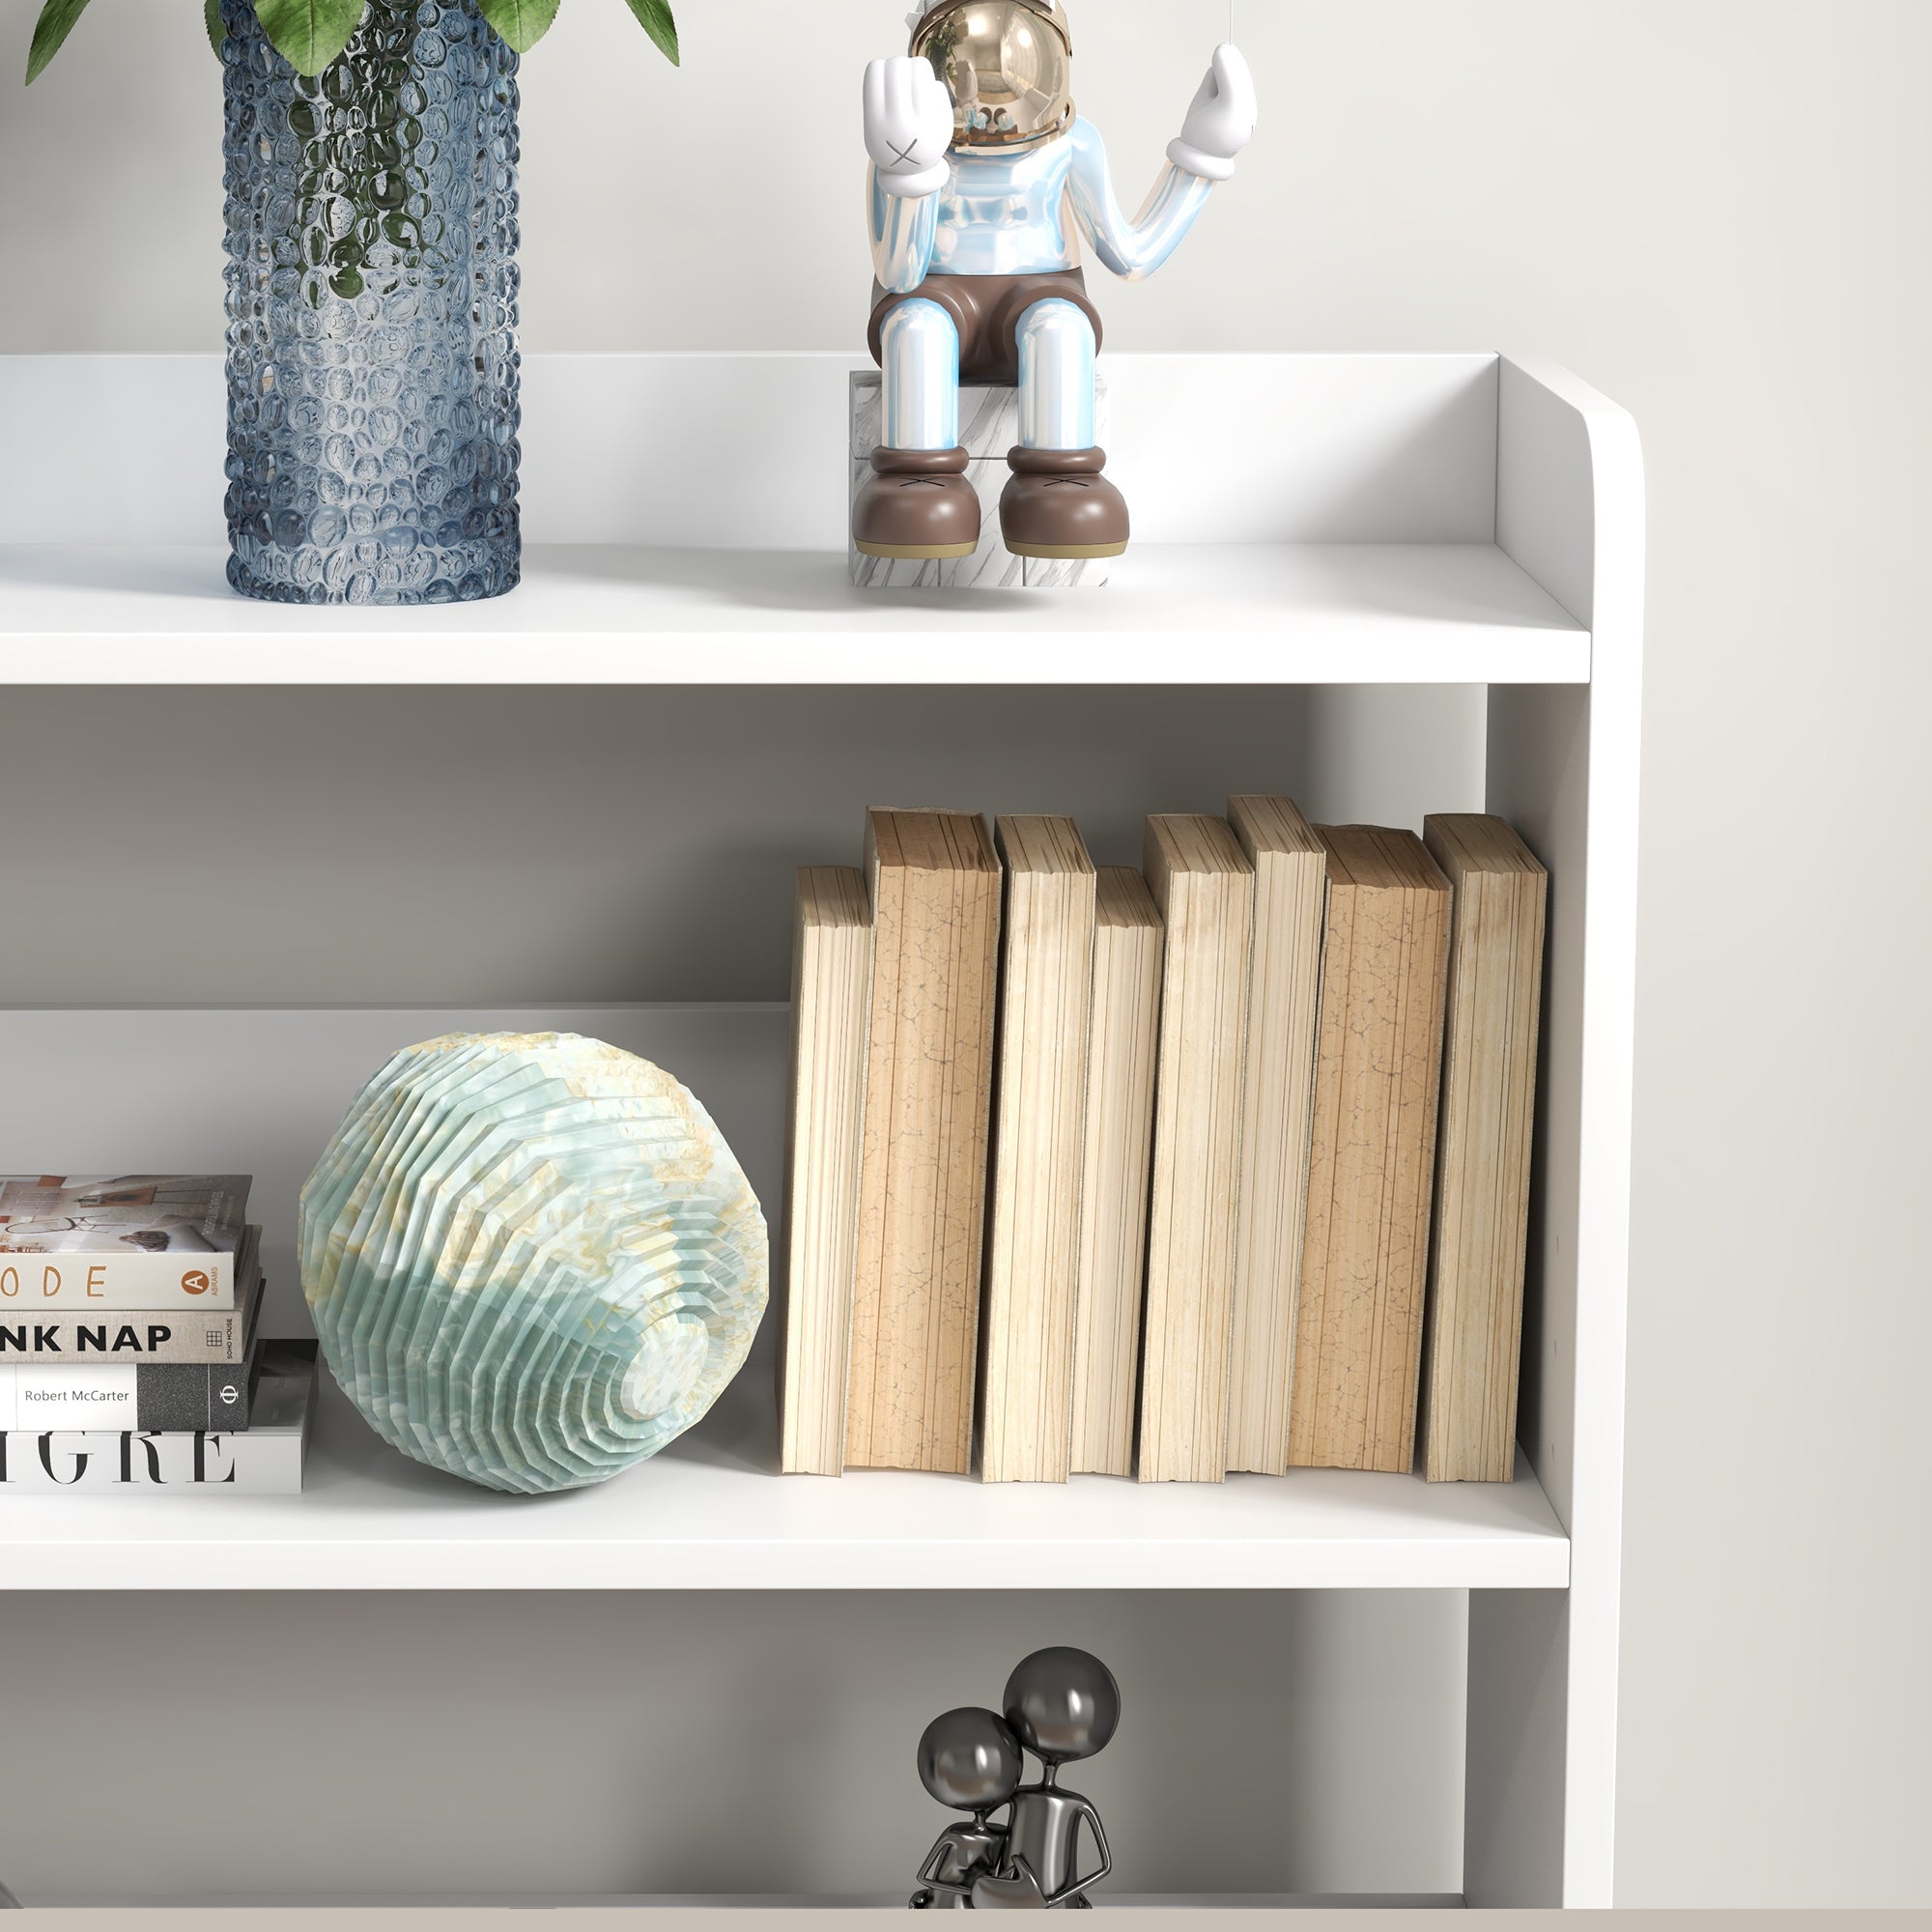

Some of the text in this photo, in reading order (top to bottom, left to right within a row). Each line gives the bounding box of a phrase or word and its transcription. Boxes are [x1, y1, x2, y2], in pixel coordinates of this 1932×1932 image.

[76, 1325, 172, 1352] NAP
[25, 1389, 129, 1402] Robert McCarter
